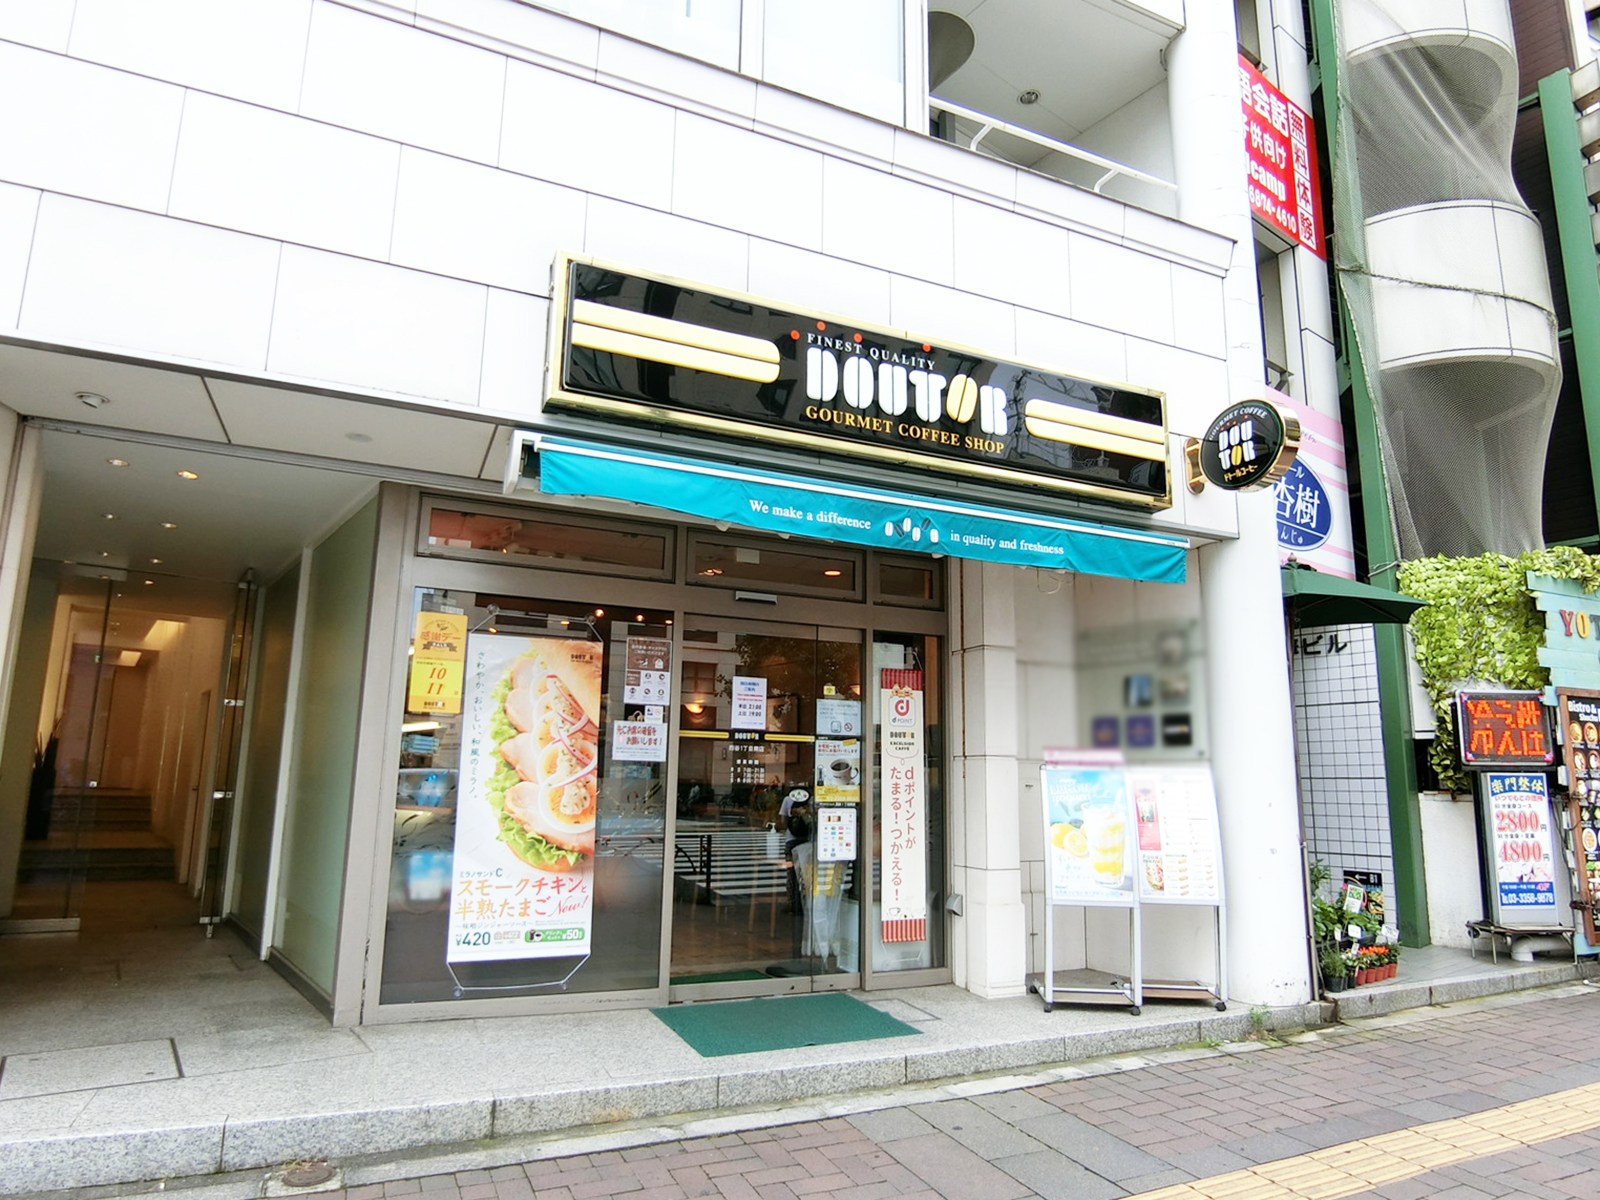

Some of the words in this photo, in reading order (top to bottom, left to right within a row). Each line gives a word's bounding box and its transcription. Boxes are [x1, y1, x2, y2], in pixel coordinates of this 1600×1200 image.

[1290, 109, 1315, 246] 無料体験
[807, 332, 863, 355] FINEST
[869, 347, 936, 371] QUALITY
[806, 346, 1008, 436] DOUTOR
[805, 405, 893, 434] GOURMET
[898, 423, 960, 446] COFFEE
[964, 436, 1005, 454] SHOP
[1208, 409, 1239, 441] GOURMET
[1240, 406, 1268, 419] COFFEE
[1223, 464, 1258, 482] ドトールコーヒー
[749, 499, 769, 513] We
[772, 506, 803, 519] make
[806, 511, 813, 521] a
[816, 511, 872, 529] difference
[1274, 476, 1320, 529] 杏樹
[951, 530, 960, 542] in
[963, 534, 997, 549] quality
[999, 539, 1017, 550] and
[1020, 540, 1065, 555] freshness
[420, 630, 461, 642] 感謝デー
[429, 667, 447, 680] 10
[427, 682, 445, 695] 11
[1567, 700, 1590, 714] Bistro
[735, 732, 759, 740] DOUTOR
[904, 766, 917, 850] dポイントが
[1495, 810, 1540, 832] 2800
[1540, 823, 1548, 833] 円
[1499, 840, 1543, 862] 4800
[1543, 853, 1551, 862] 円
[457, 876, 587, 896] スモークチキンと
[455, 896, 551, 921] 半熟たまご
[455, 931, 491, 946] ¥420
